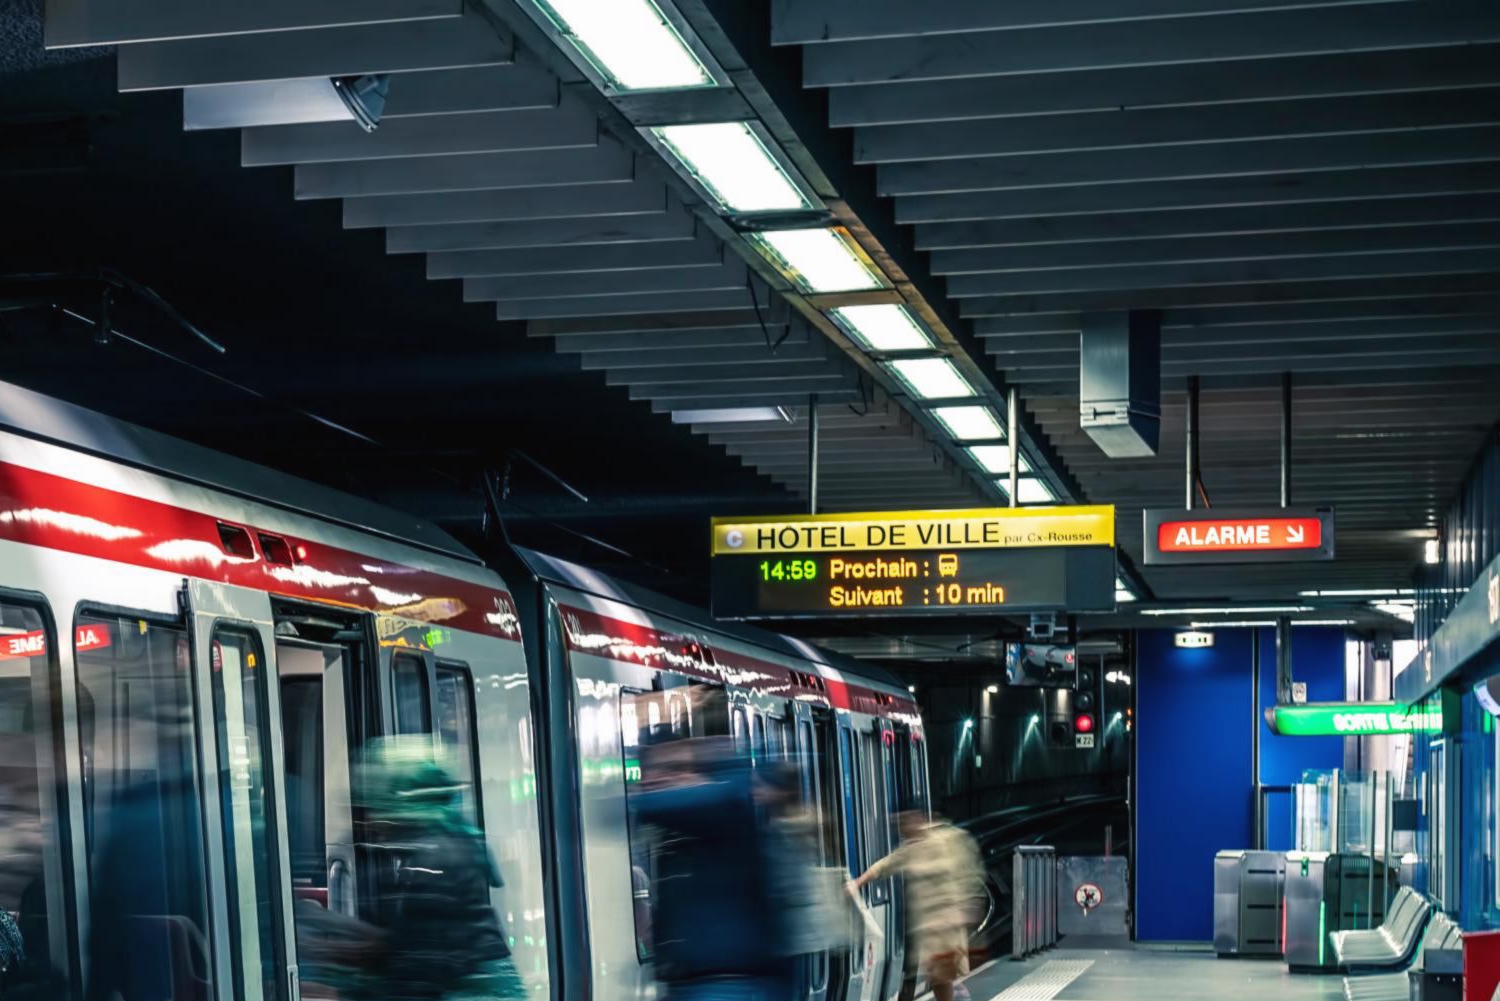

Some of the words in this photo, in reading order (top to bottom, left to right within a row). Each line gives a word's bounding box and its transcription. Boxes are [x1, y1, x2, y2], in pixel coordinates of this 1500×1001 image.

[726, 530, 743, 547] C
[867, 525, 906, 546] DE
[916, 522, 999, 545] VILLE
[1004, 533, 1023, 546] par
[1027, 532, 1092, 543] Cx-Rousse
[1175, 525, 1270, 546] ALARME
[760, 560, 816, 581] 14:59
[830, 557, 917, 579] Prochain
[830, 585, 903, 606] Suivant
[936, 583, 961, 604] 10
[967, 583, 1004, 603] min
